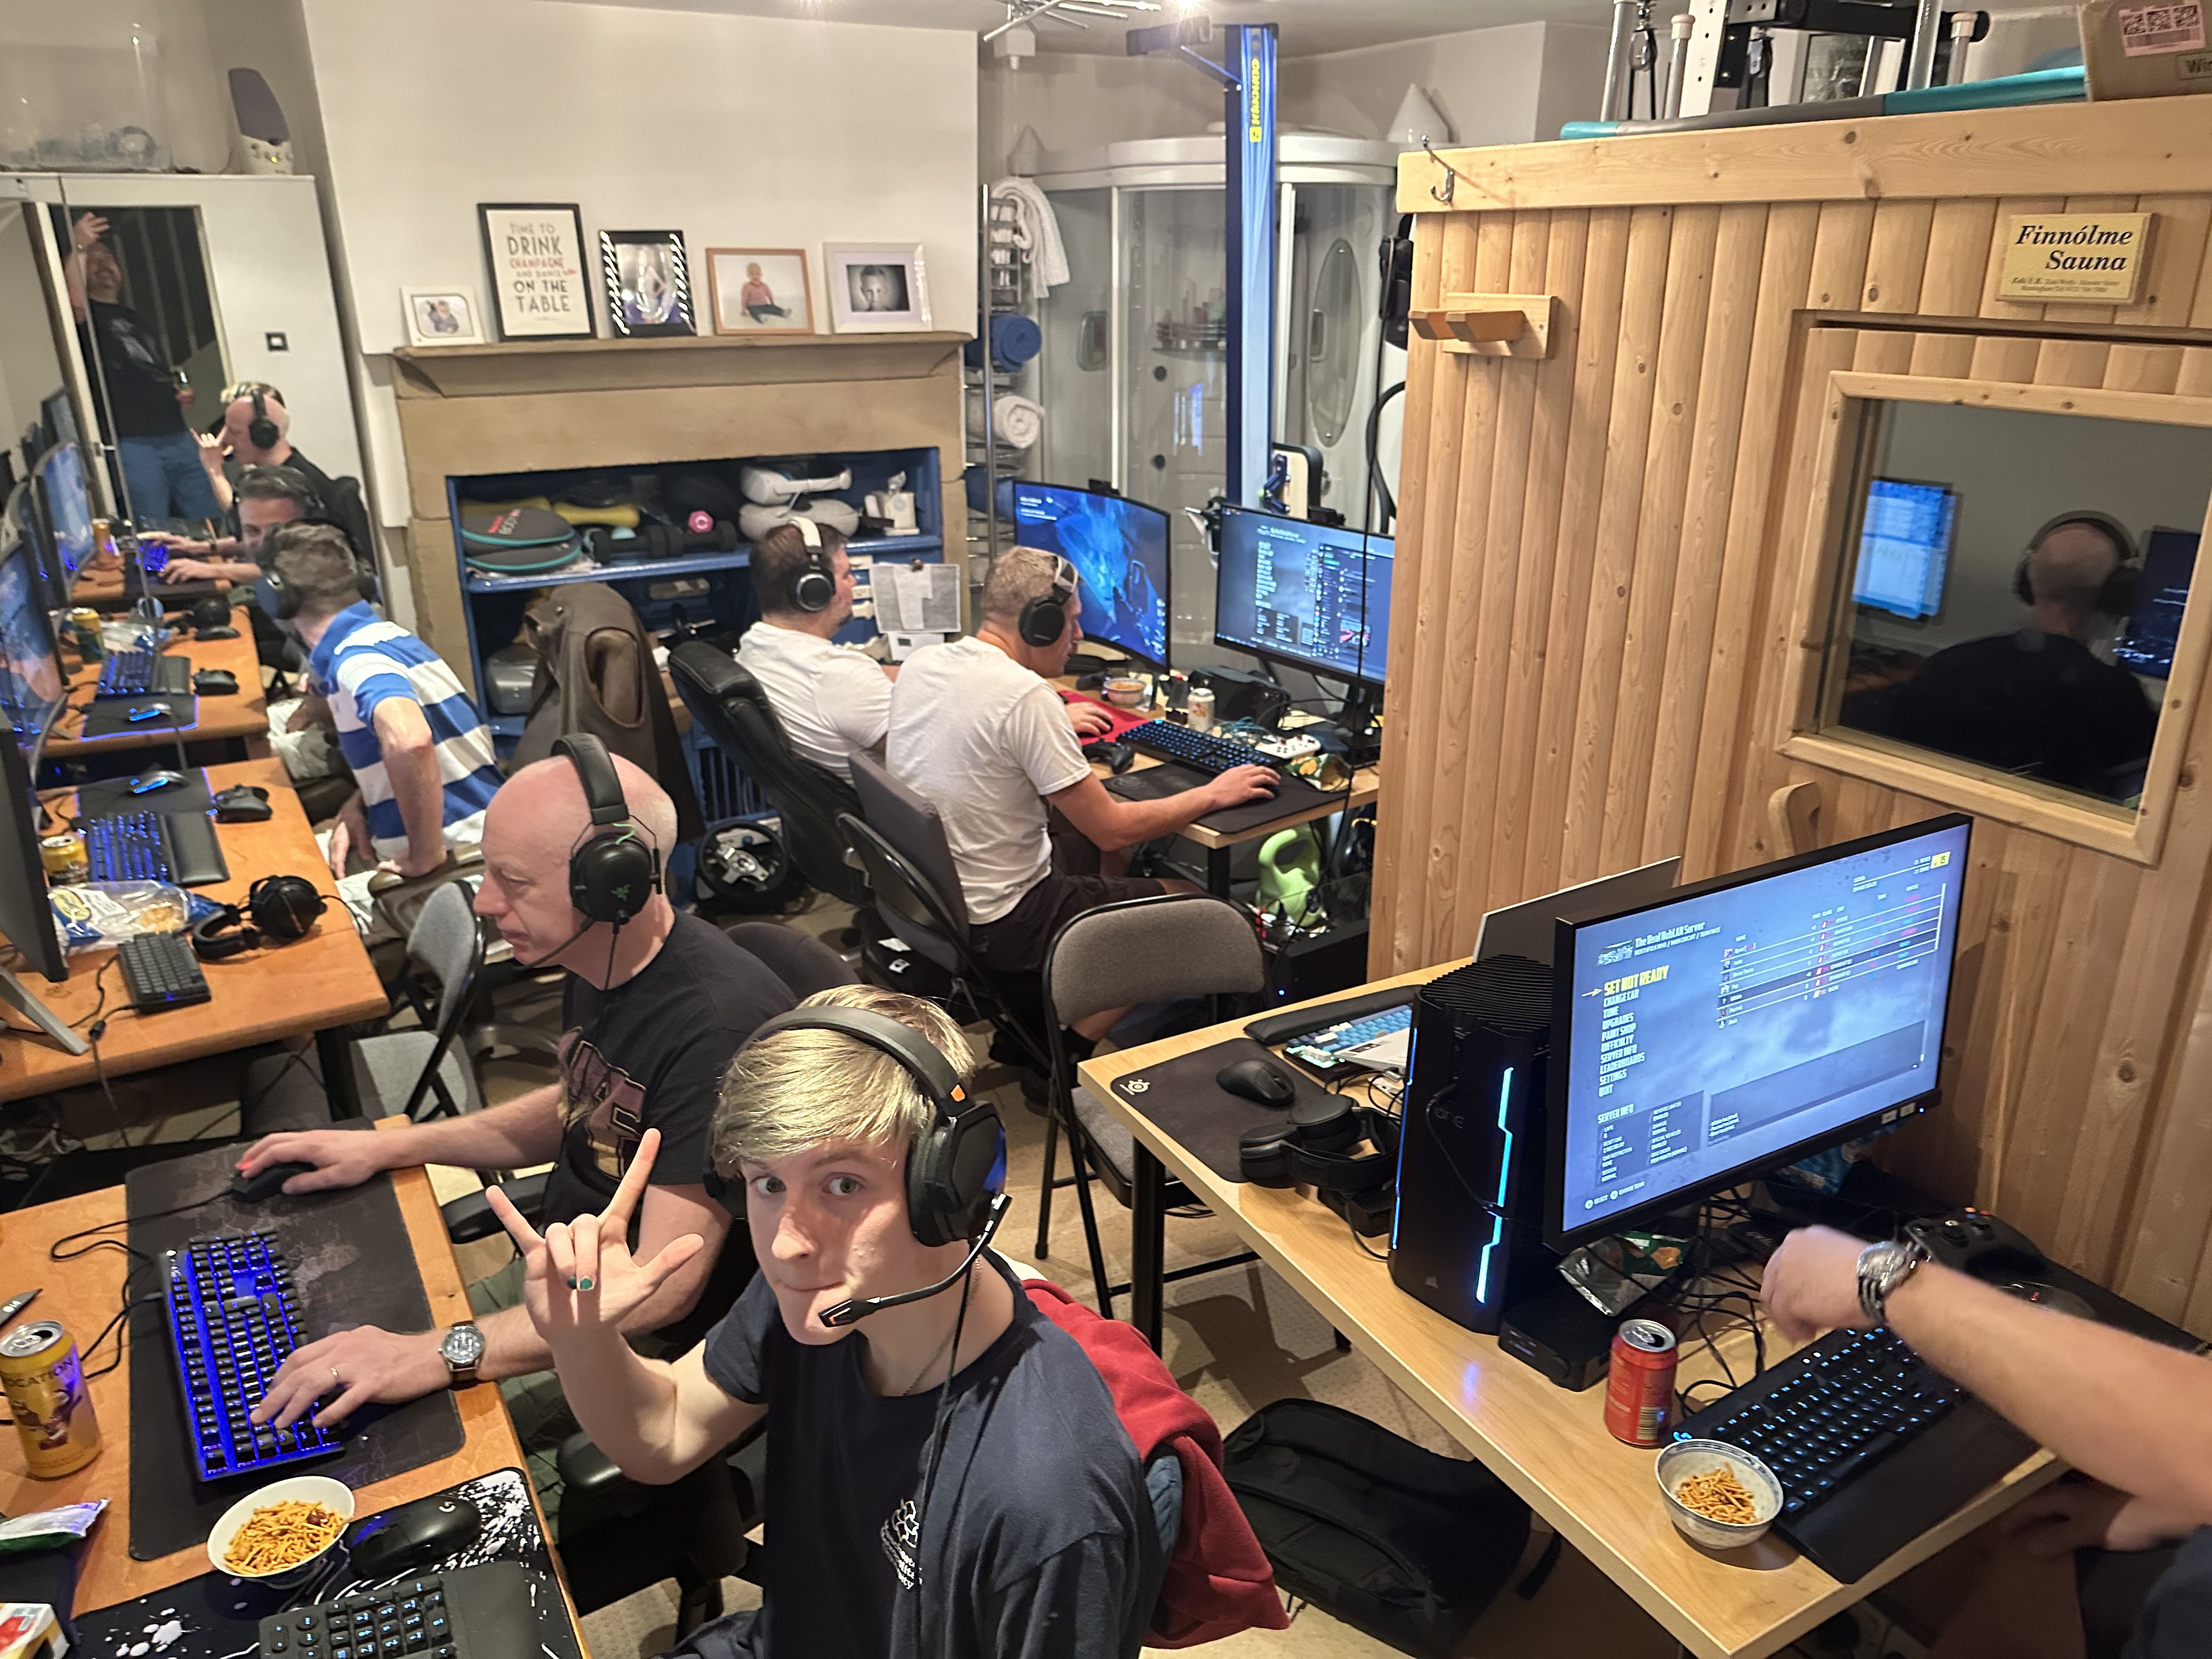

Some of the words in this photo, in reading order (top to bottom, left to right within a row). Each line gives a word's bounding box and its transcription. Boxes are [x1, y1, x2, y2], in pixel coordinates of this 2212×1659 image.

[510, 223, 534, 234] TIME
[540, 223, 556, 234] TO
[2015, 224, 2134, 245] Finnólme
[507, 236, 562, 256] DRINK
[509, 257, 564, 269] CHAMPAGNE
[2045, 250, 2128, 270] Sauna
[514, 280, 535, 293] ON
[542, 280, 567, 292] THE
[516, 295, 571, 313] TABLE
[1635, 936, 1646, 948] The
[1684, 919, 1705, 934] Server
[1604, 978, 1620, 996] SET
[1621, 973, 1639, 991] NOT
[1639, 964, 1669, 986] READY
[1603, 992, 1627, 1008] CHANGE
[1627, 988, 1639, 1001] CAR
[1602, 1012, 1634, 1030] UPGRADES
[1601, 1027, 1620, 1042] PAINT
[1620, 1022, 1636, 1036] SHOP
[1600, 1048, 1623, 1064] SERVER
[1623, 1043, 1637, 1057] INFO
[1601, 1034, 1634, 1053] DIFFICULTY
[1600, 1052, 1645, 1075] LEADERBOARDS
[1599, 1068, 1627, 1086] SETTINGS
[1598, 1084, 1613, 1098] QUIT
[1598, 1108, 1620, 1125] SERVER
[1620, 1103, 1634, 1116] INFO
